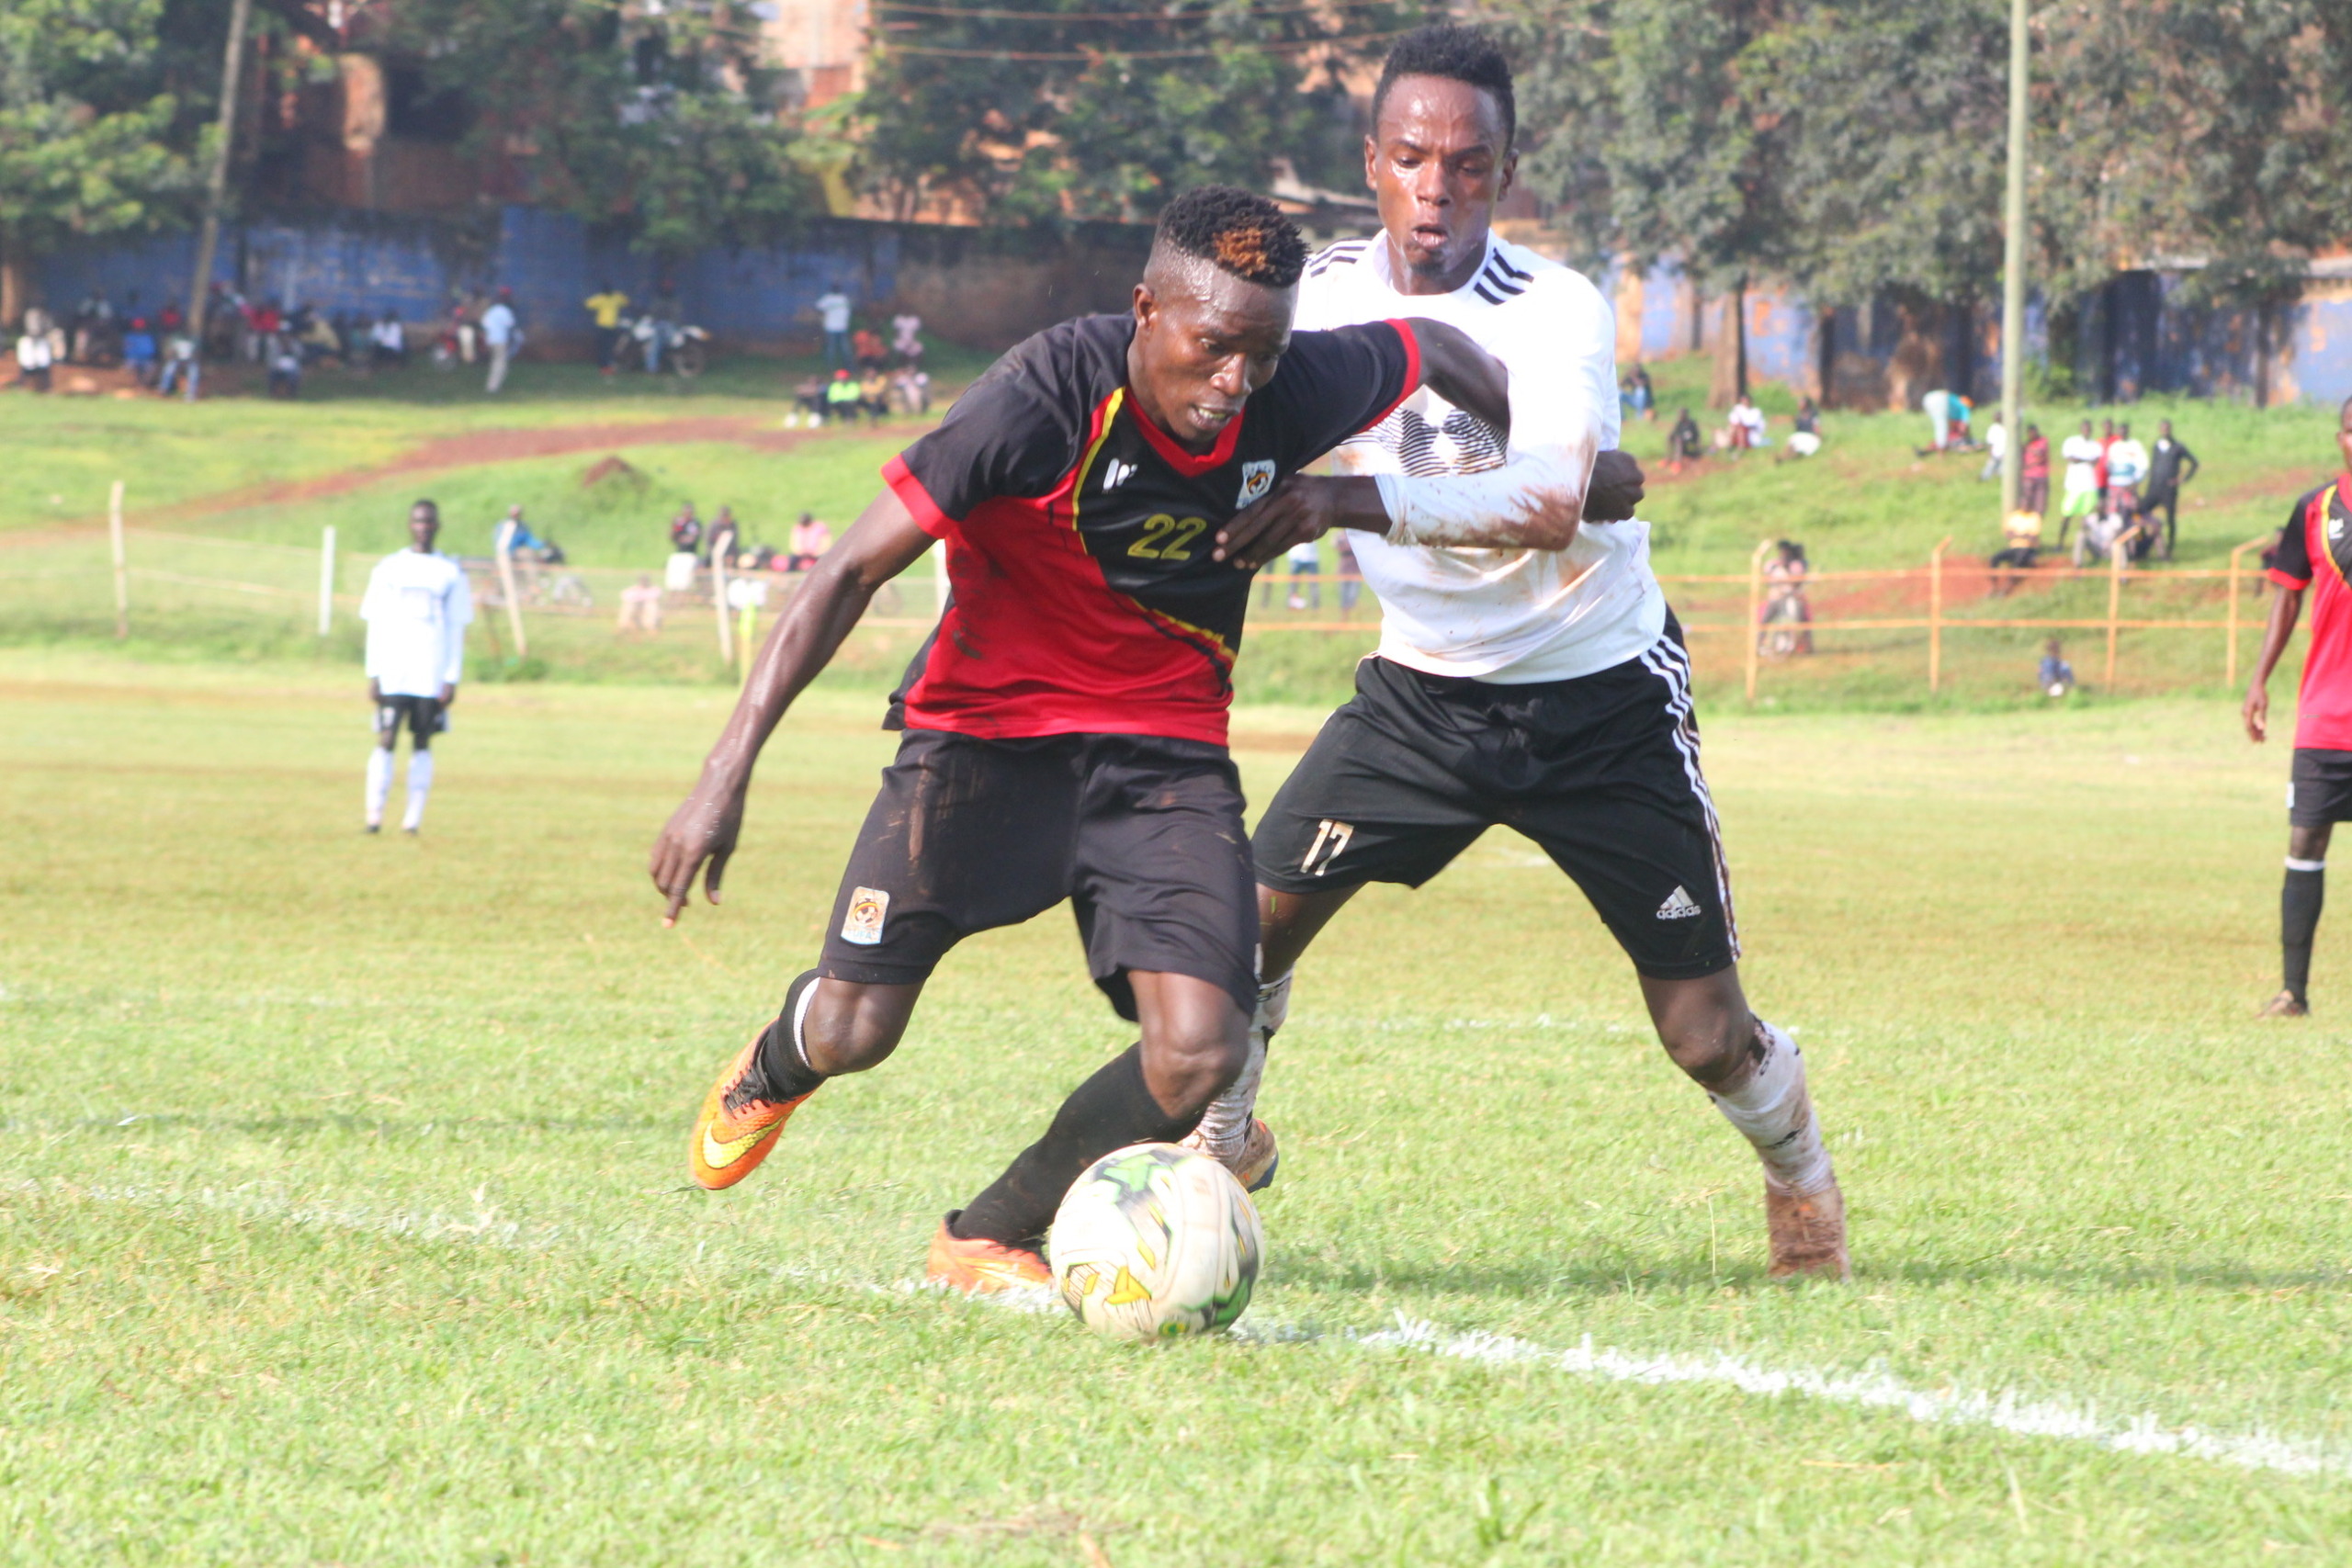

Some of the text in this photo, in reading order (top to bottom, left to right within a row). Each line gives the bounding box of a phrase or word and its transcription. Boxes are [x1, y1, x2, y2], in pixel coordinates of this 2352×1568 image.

[1127, 513, 1207, 559] 22
[1299, 818, 1354, 876] 17
[1657, 905, 1702, 920] adidas
